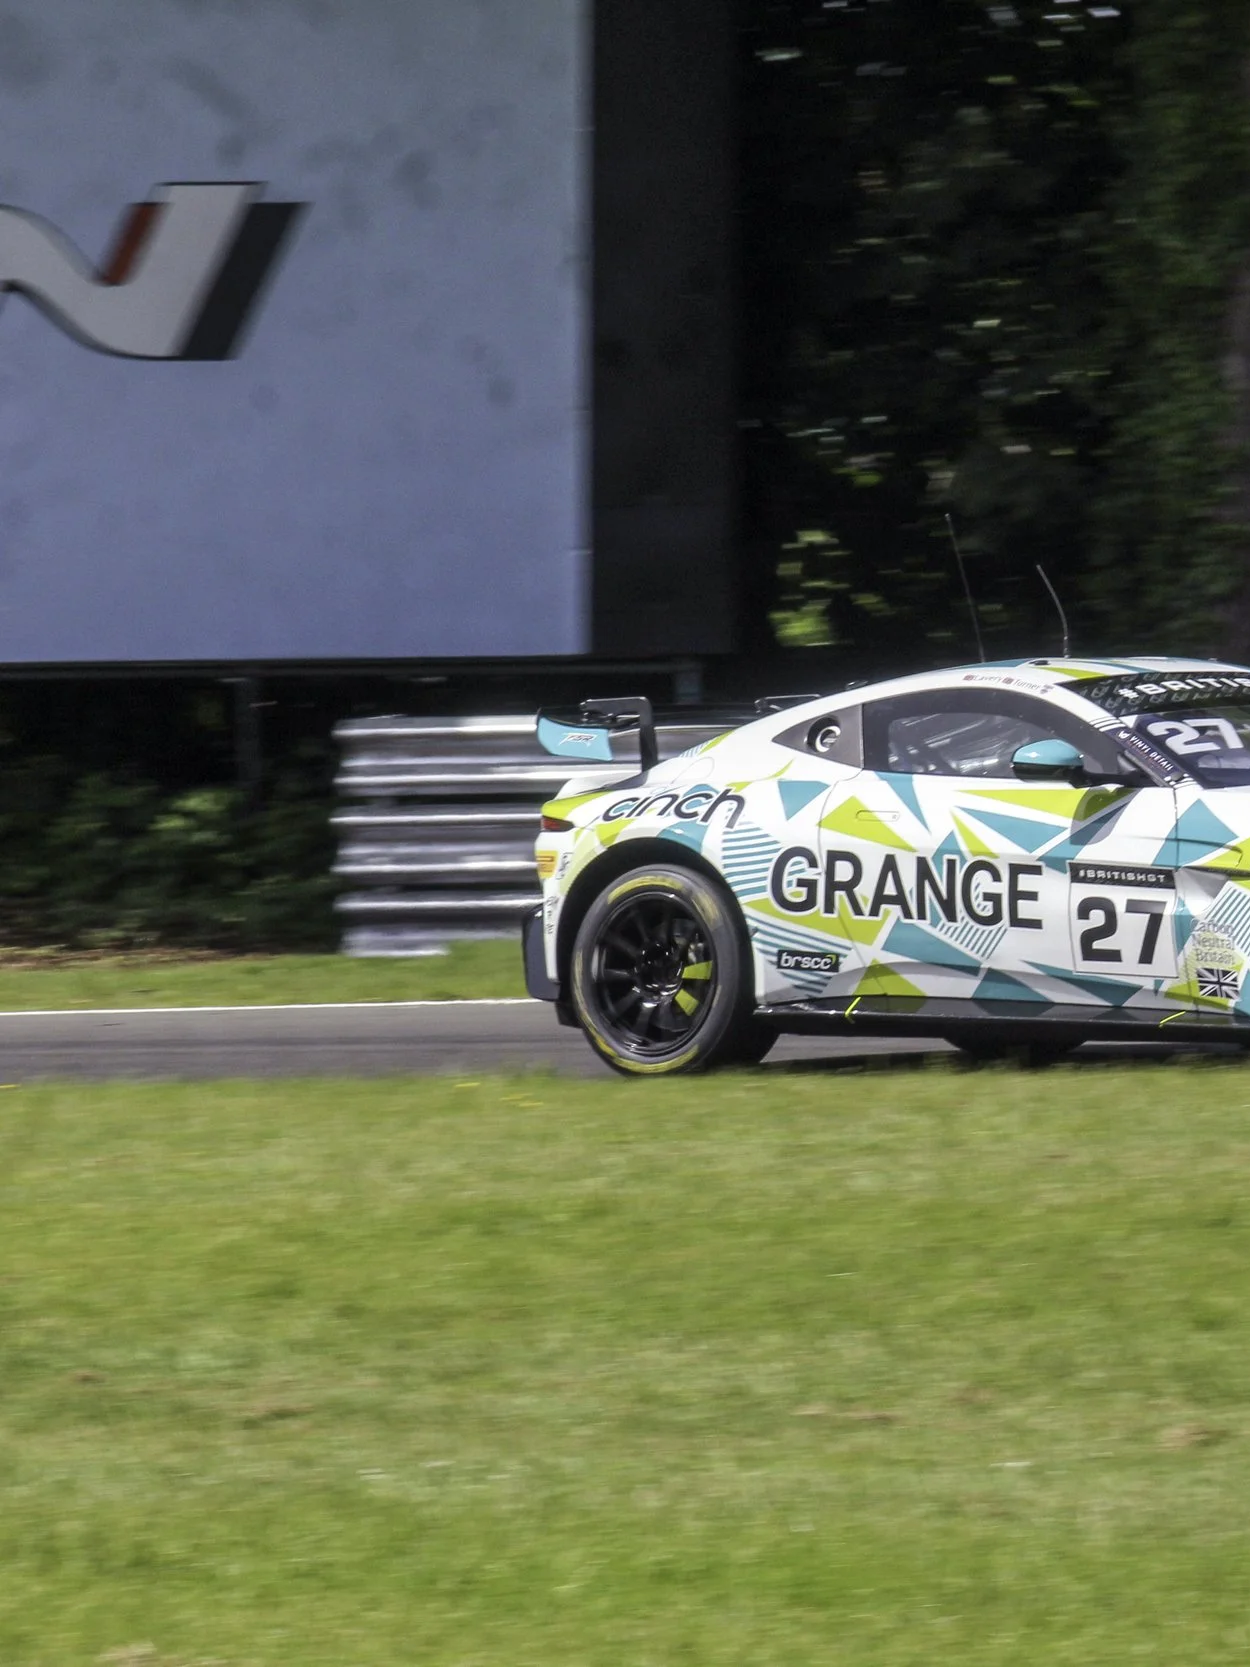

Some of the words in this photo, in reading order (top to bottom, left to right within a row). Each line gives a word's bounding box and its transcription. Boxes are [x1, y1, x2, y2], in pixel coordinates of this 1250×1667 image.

[1146, 718, 1243, 755] 27
[602, 788, 746, 830] cinch
[770, 846, 1044, 930] GRANGE
[1078, 869, 1166, 883] #BRITISHGT
[1077, 896, 1167, 965] 27
[779, 952, 834, 970] brscc
